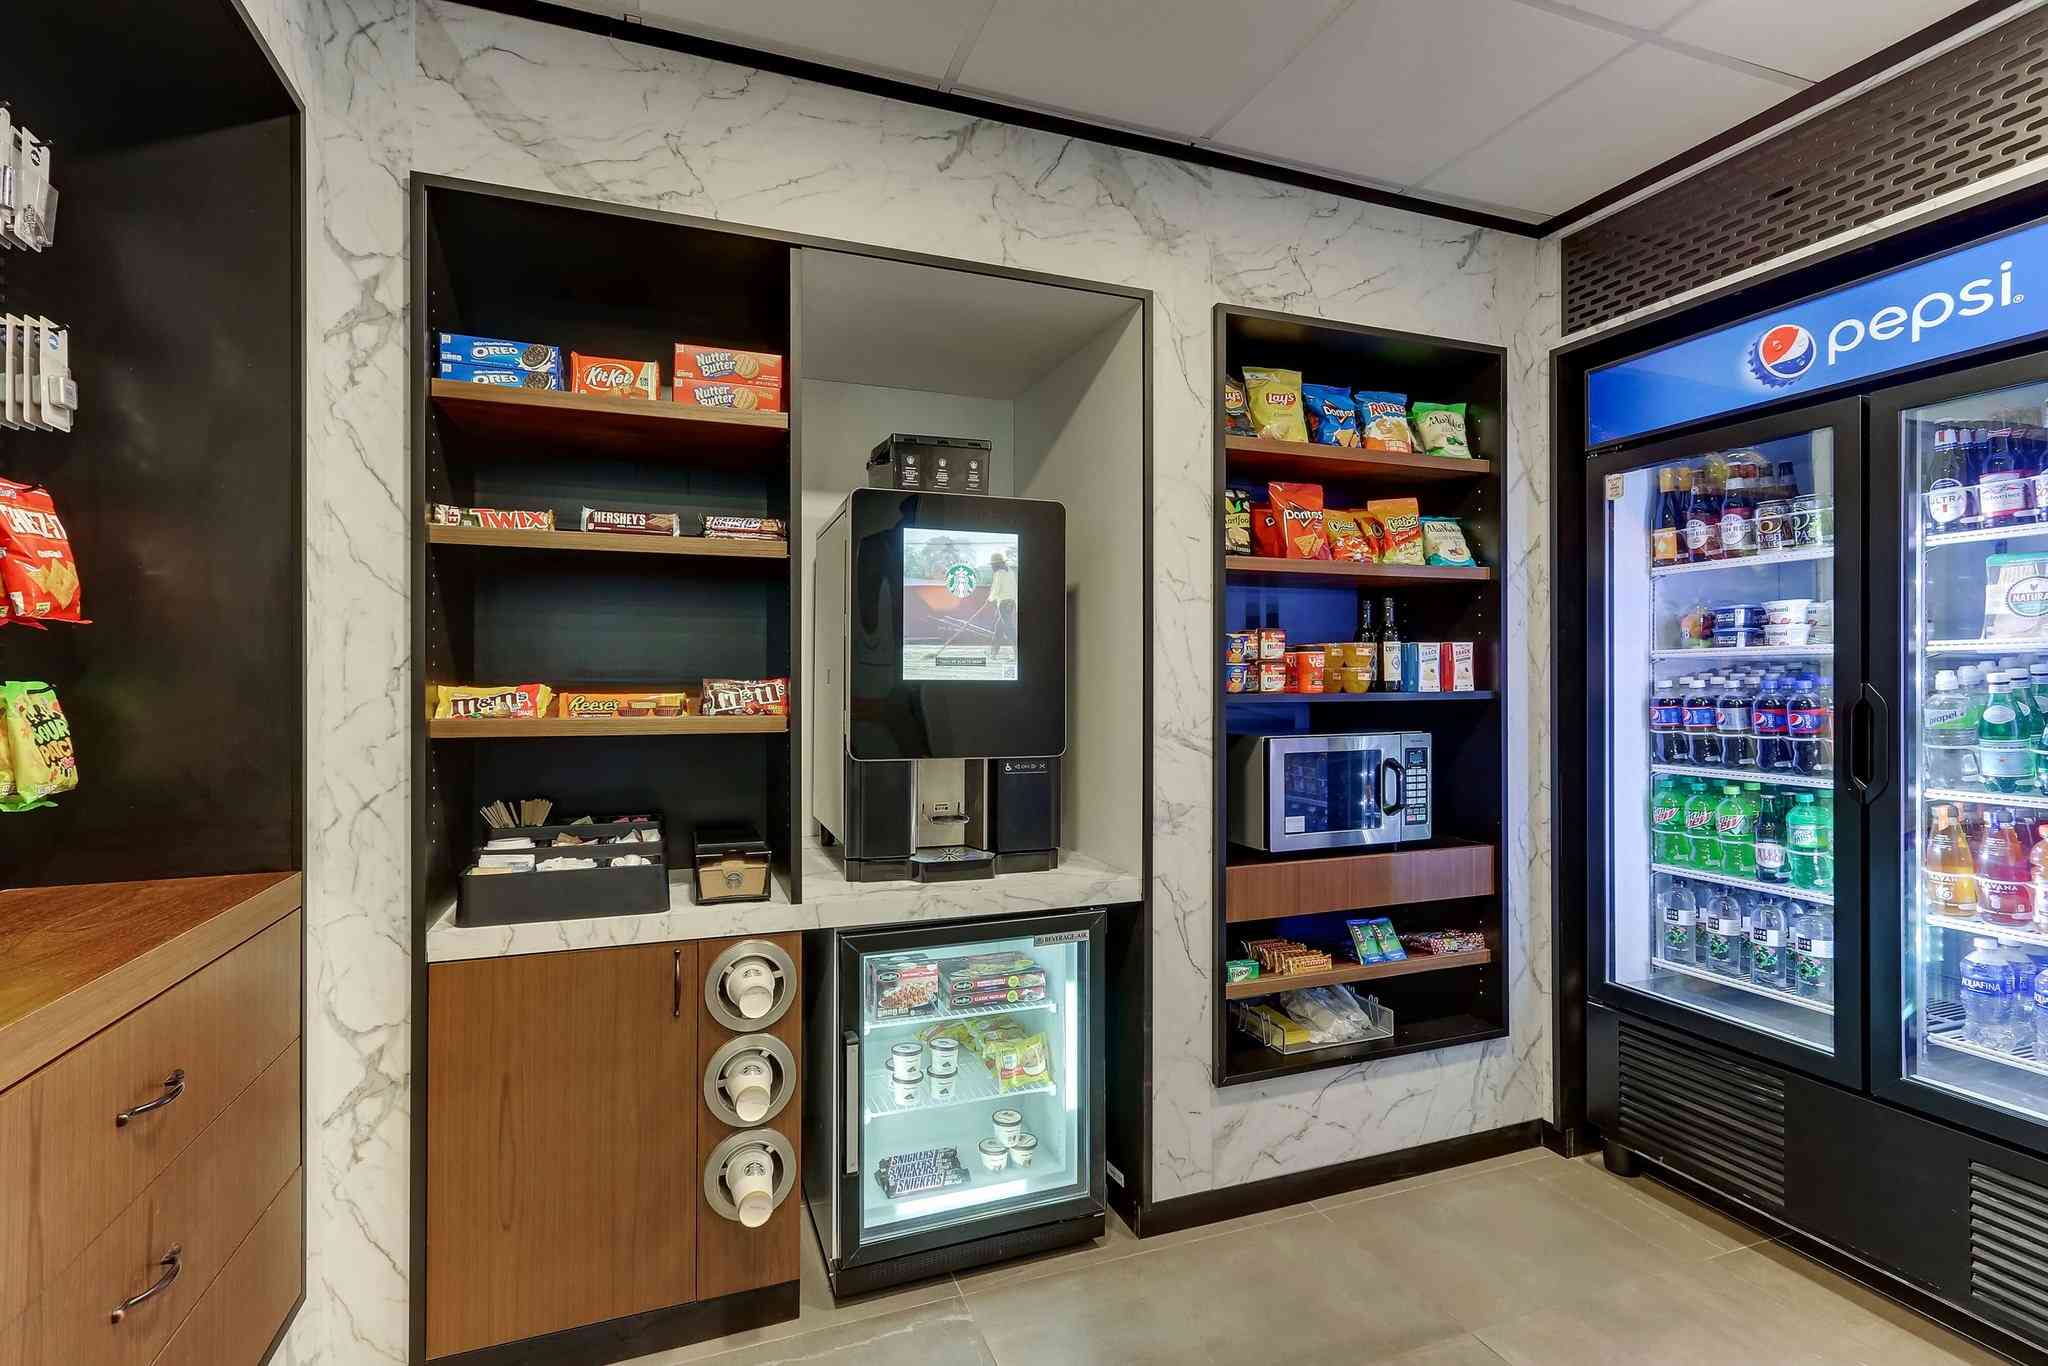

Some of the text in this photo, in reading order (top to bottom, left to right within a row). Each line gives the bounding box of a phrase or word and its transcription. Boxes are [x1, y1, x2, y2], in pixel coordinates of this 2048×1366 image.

[1828, 261, 2013, 366] pepsi
[471, 345, 519, 359] OREO
[696, 352, 731, 366] Nutter
[701, 361, 735, 377] Butter
[472, 374, 519, 387] OREO
[694, 386, 730, 400] Nutter
[470, 509, 550, 529] TWIX
[593, 511, 646, 525] HERSHEY'S
[1286, 509, 1323, 520] Doritos
[32, 718, 71, 745] SOUR
[1961, 977, 2001, 992] AQUAFINA
[898, 1173, 943, 1192] SNICKERS
